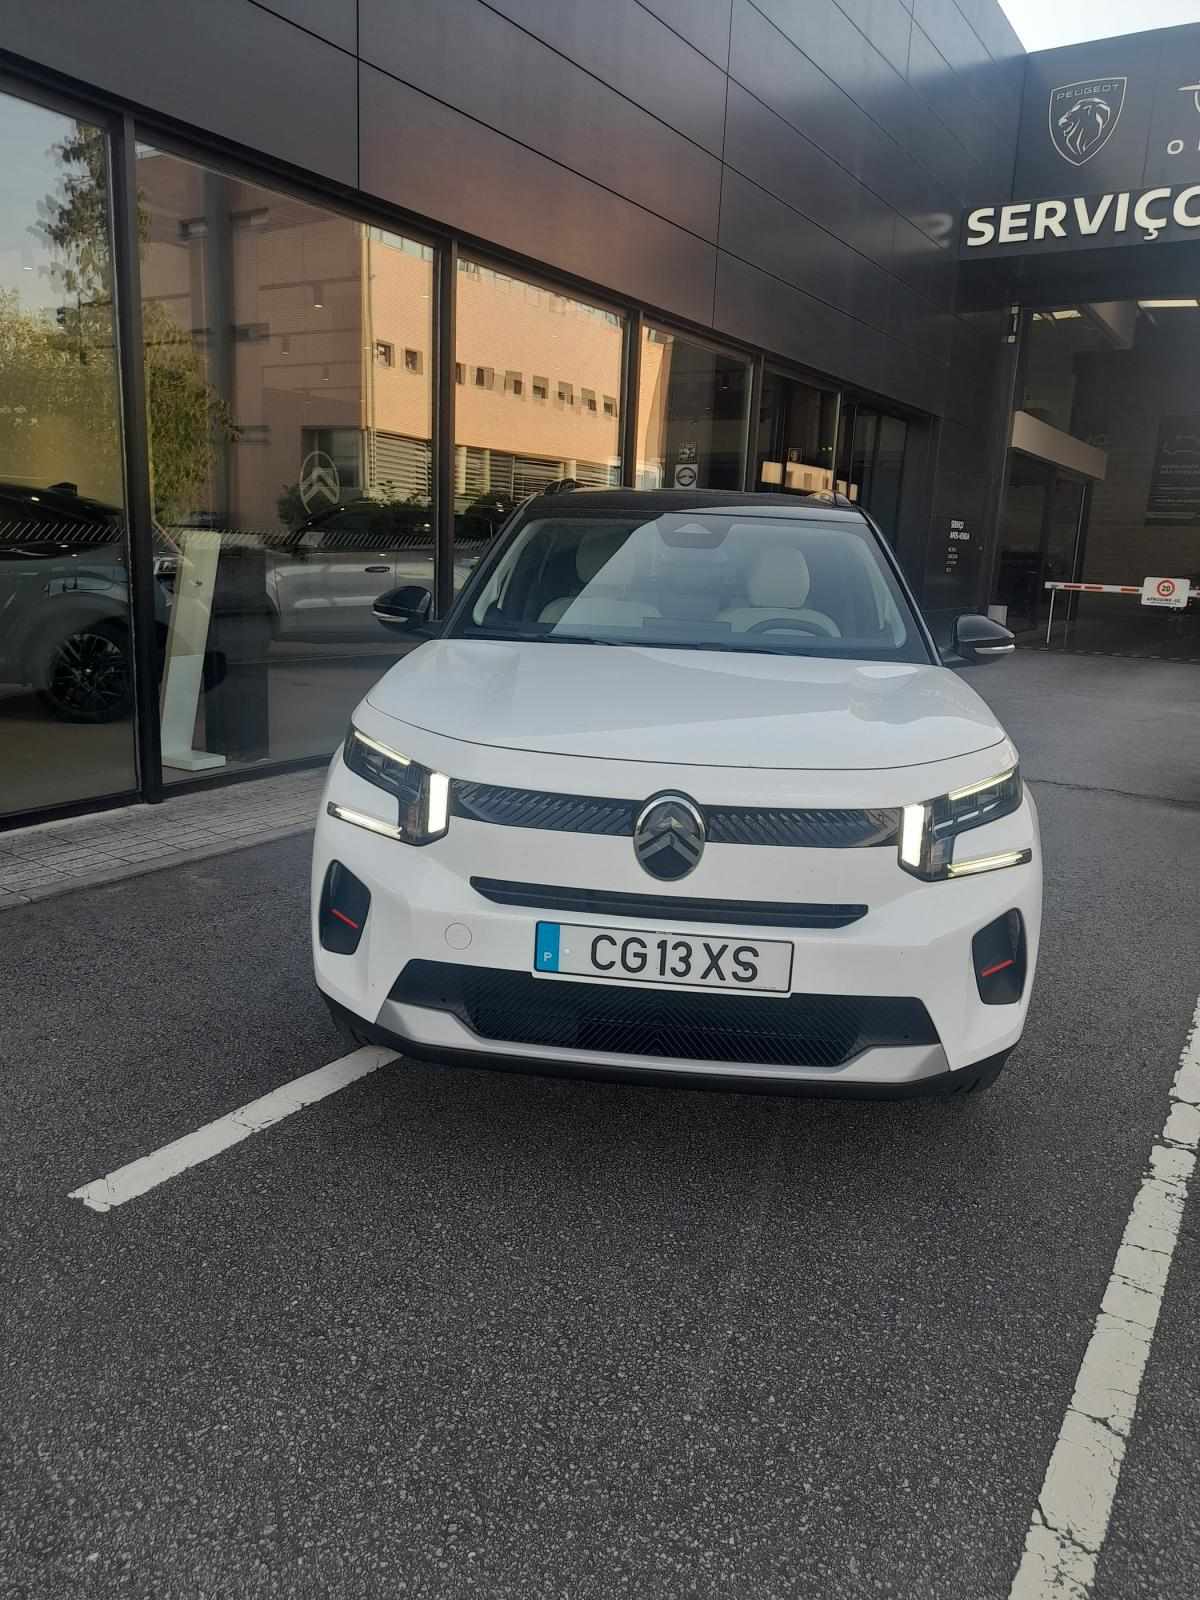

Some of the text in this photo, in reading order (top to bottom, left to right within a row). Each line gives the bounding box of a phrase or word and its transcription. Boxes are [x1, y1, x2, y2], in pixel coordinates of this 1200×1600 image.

[1056, 83, 1120, 101] PEUGEOT
[1167, 138, 1200, 155] O
[543, 951, 553, 963] P
